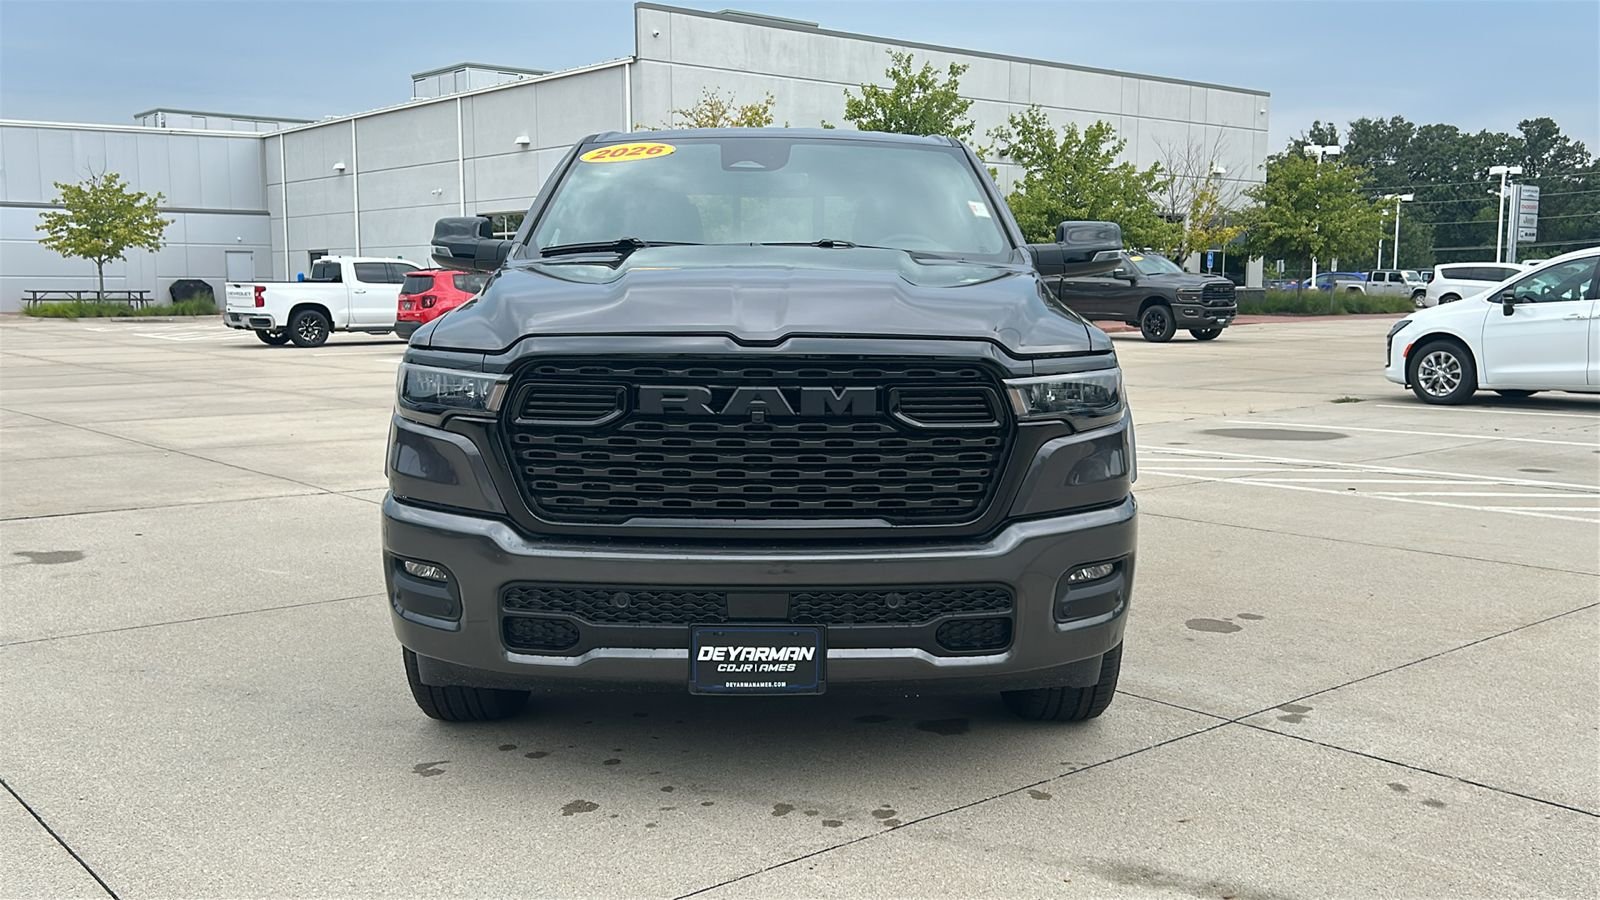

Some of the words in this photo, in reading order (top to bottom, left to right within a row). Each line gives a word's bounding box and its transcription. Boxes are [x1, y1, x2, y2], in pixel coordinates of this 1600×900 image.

[590, 146, 666, 160] 2026
[639, 385, 877, 415] RAM
[697, 646, 815, 661] DEYARMAN
[717, 663, 753, 672] CDJR
[759, 663, 796, 672] AMES
